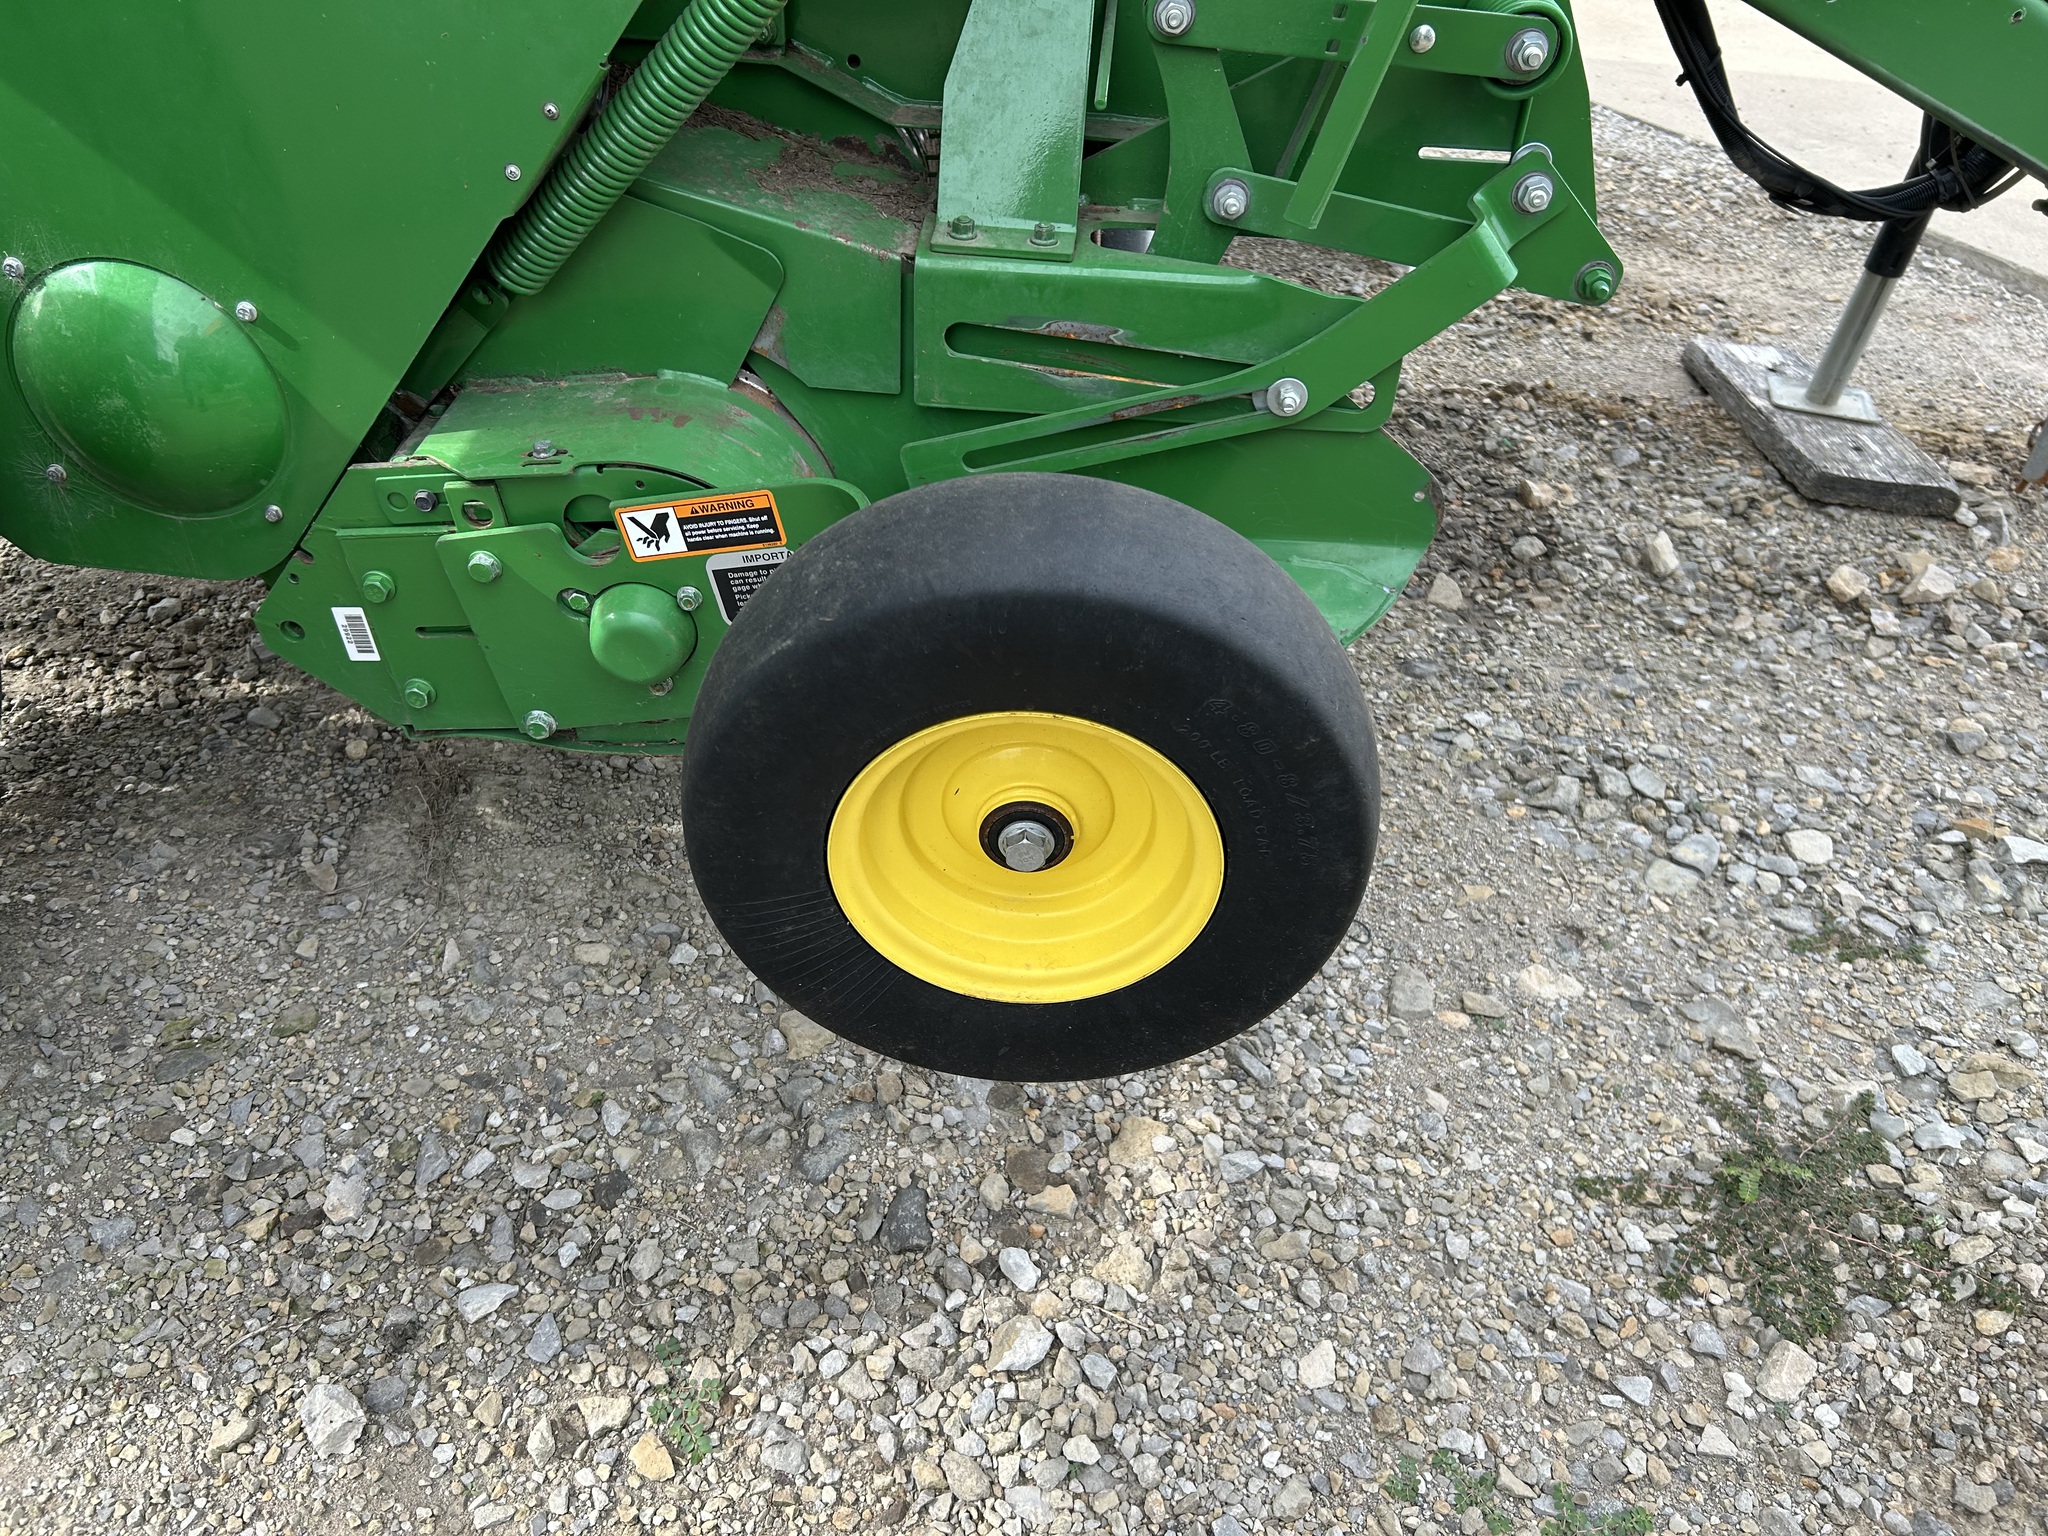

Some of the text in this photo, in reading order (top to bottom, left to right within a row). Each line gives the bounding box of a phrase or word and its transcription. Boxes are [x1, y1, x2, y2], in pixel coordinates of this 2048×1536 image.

[698, 499, 755, 514] WARNING
[683, 522, 698, 530] AVOID
[699, 520, 716, 529] INJURY
[692, 529, 706, 537] power
[707, 527, 722, 535] before
[747, 523, 759, 531] Keep
[729, 531, 749, 539] machine
[728, 569, 758, 579] Damage
[760, 568, 767, 576] to
[745, 575, 767, 583] result
[732, 584, 750, 593] gage
